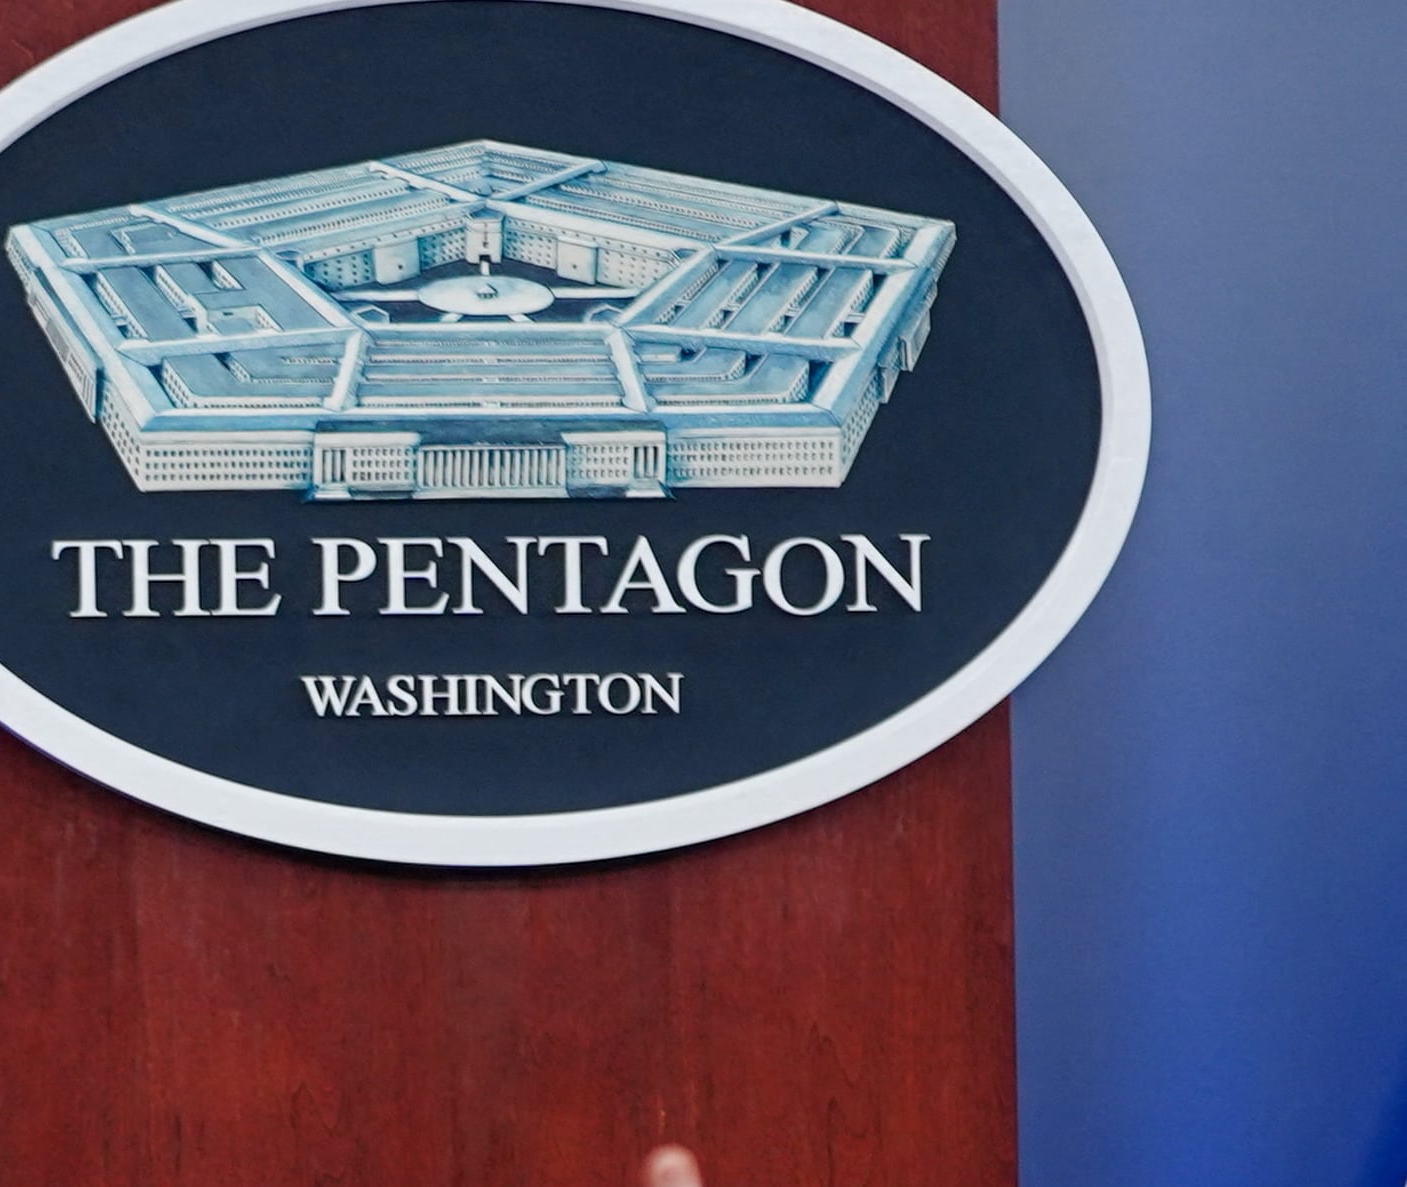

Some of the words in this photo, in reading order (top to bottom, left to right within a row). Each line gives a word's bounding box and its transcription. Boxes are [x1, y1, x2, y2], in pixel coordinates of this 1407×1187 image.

[50, 537, 282, 618] THE
[310, 534, 932, 616] PENTAGON
[301, 672, 683, 717] WASHINGTON
